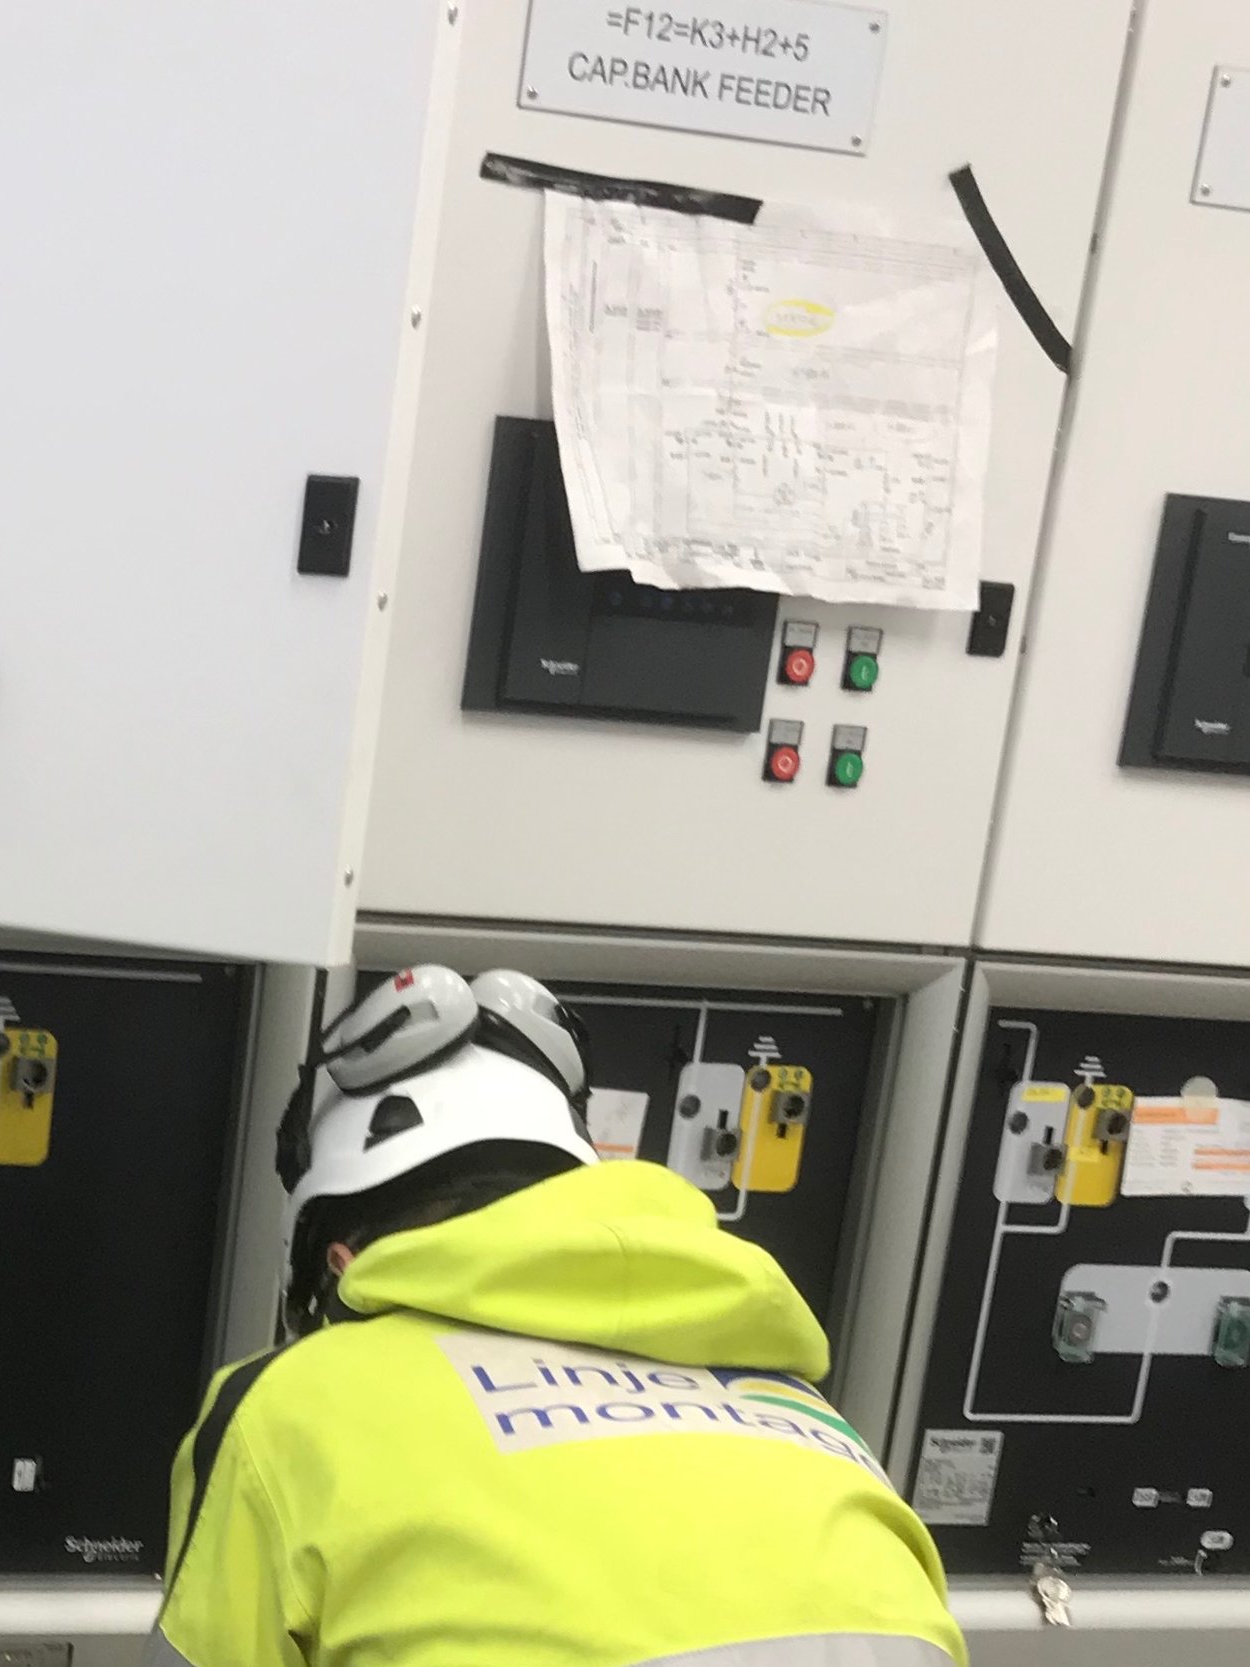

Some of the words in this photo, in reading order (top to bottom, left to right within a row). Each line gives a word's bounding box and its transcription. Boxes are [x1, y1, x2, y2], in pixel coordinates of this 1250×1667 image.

[606, 6, 810, 62] =F12=K3+H2+5
[567, 51, 711, 99] CAP.BANK
[717, 71, 833, 116] FEEDER
[471, 1358, 701, 1394] Linje
